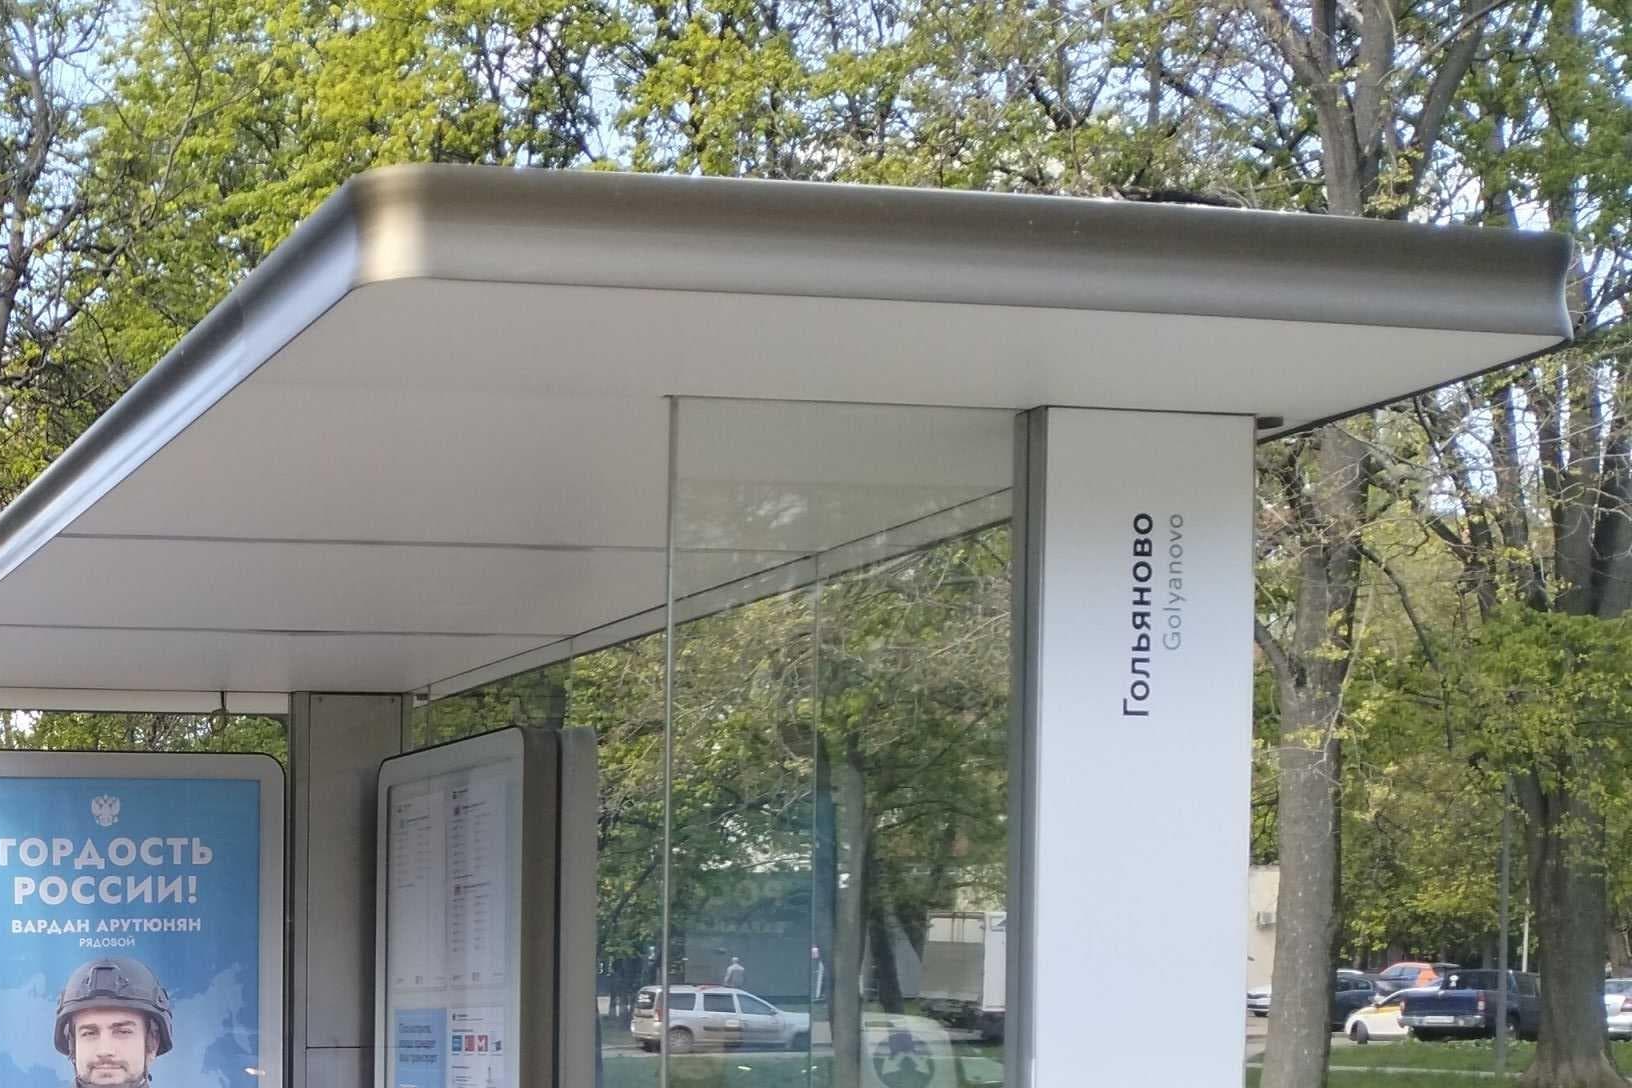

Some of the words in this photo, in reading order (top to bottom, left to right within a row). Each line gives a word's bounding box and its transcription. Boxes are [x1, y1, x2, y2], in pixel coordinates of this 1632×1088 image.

[1162, 513, 1186, 650] Golyanovo
[1123, 513, 1153, 716] Гольяново
[0, 836, 214, 870] ГОРДОСТЬ
[13, 875, 198, 905] РОССИИ!
[10, 919, 90, 935] ВАРДАН
[96, 917, 202, 933] АРУТЮНЯН
[79, 935, 136, 949] РЯДОВОЙ
